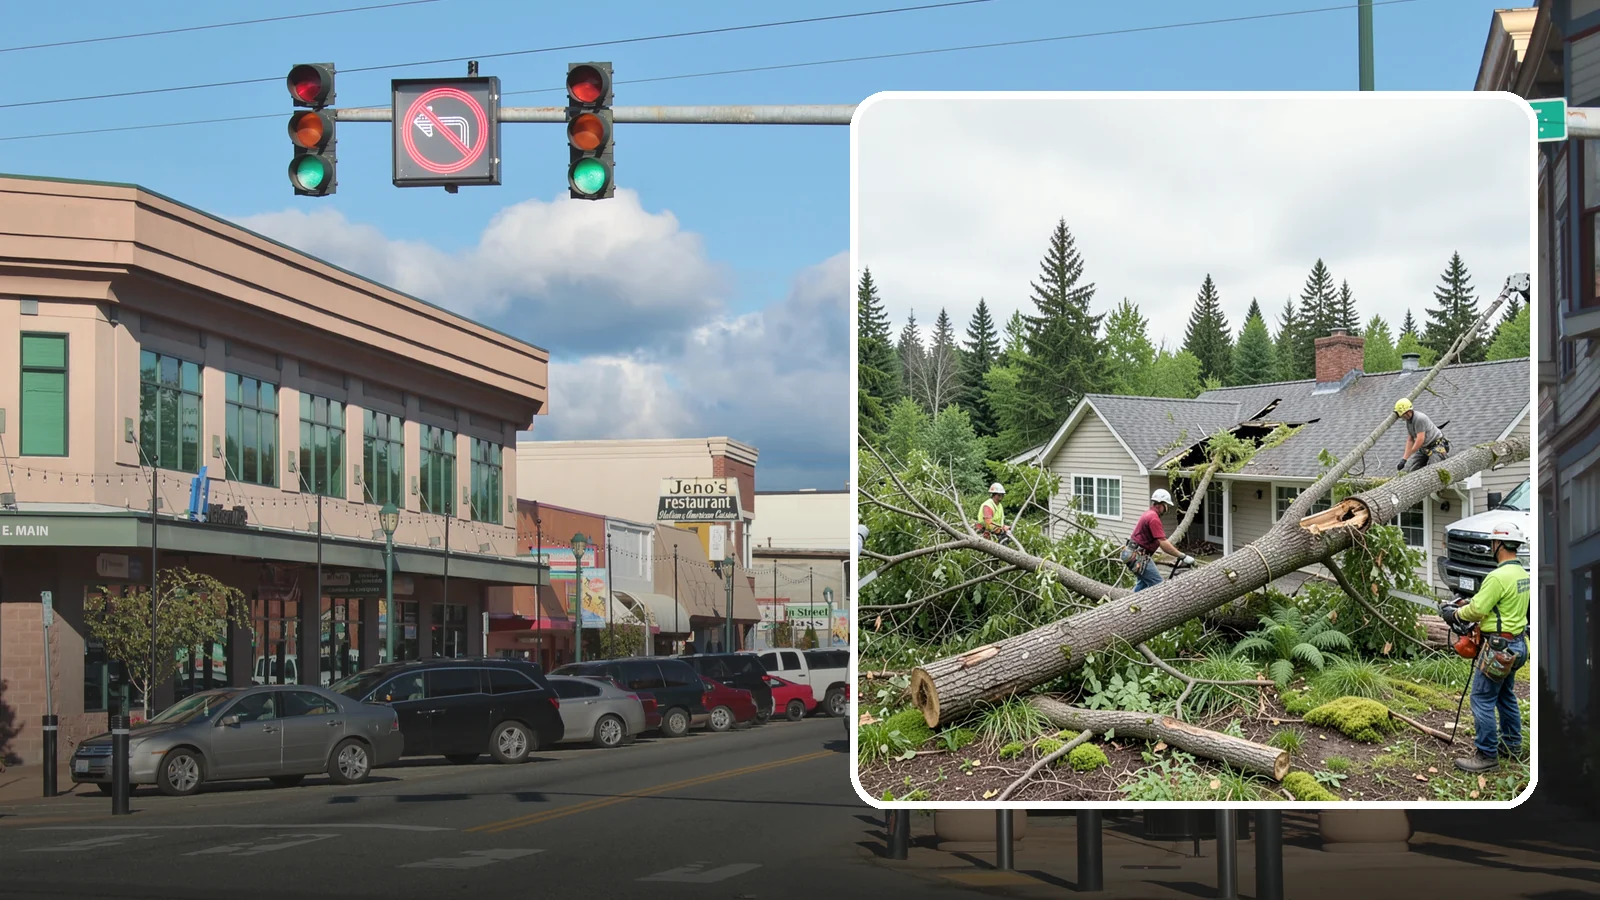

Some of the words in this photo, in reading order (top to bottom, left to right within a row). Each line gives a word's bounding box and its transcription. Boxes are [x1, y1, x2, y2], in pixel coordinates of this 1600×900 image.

[670, 480, 727, 494] Jeno's
[665, 496, 731, 509] restaurant
[658, 510, 682, 519] Italian
[686, 510, 714, 519] American
[715, 509, 738, 519] Cuisine
[2, 525, 13, 536] E.
[15, 525, 49, 537] MAIN
[797, 608, 828, 616] Street
